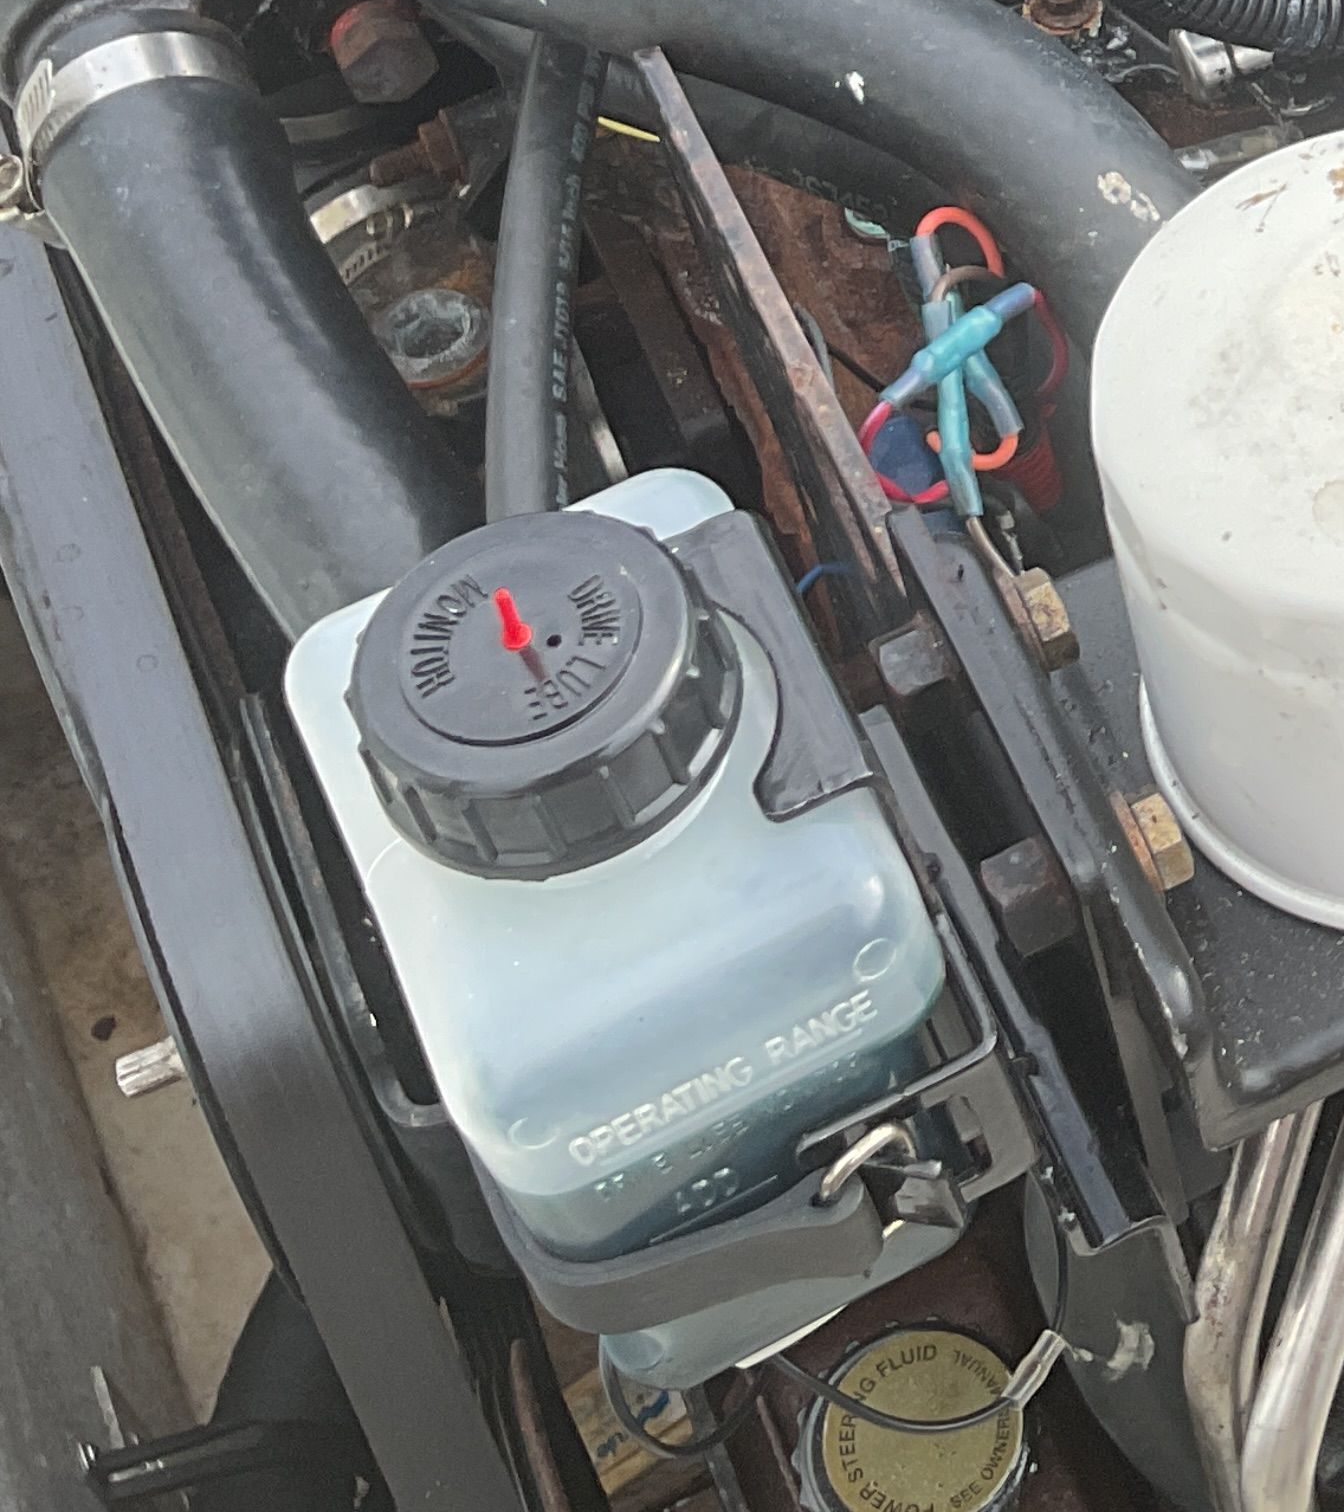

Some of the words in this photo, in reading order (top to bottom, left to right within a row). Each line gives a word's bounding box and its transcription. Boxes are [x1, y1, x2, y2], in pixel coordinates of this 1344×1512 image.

[552, 350, 570, 402] SAE
[410, 574, 491, 700] MONITOR
[566, 574, 622, 648] DRIVE
[523, 653, 607, 722] LUBE
[567, 1054, 755, 1168] OPERATING
[762, 990, 879, 1075] RANGE
[839, 1376, 877, 1483] STEERNG
[875, 1343, 938, 1378] FLUID
[949, 1482, 983, 1509] SEE
